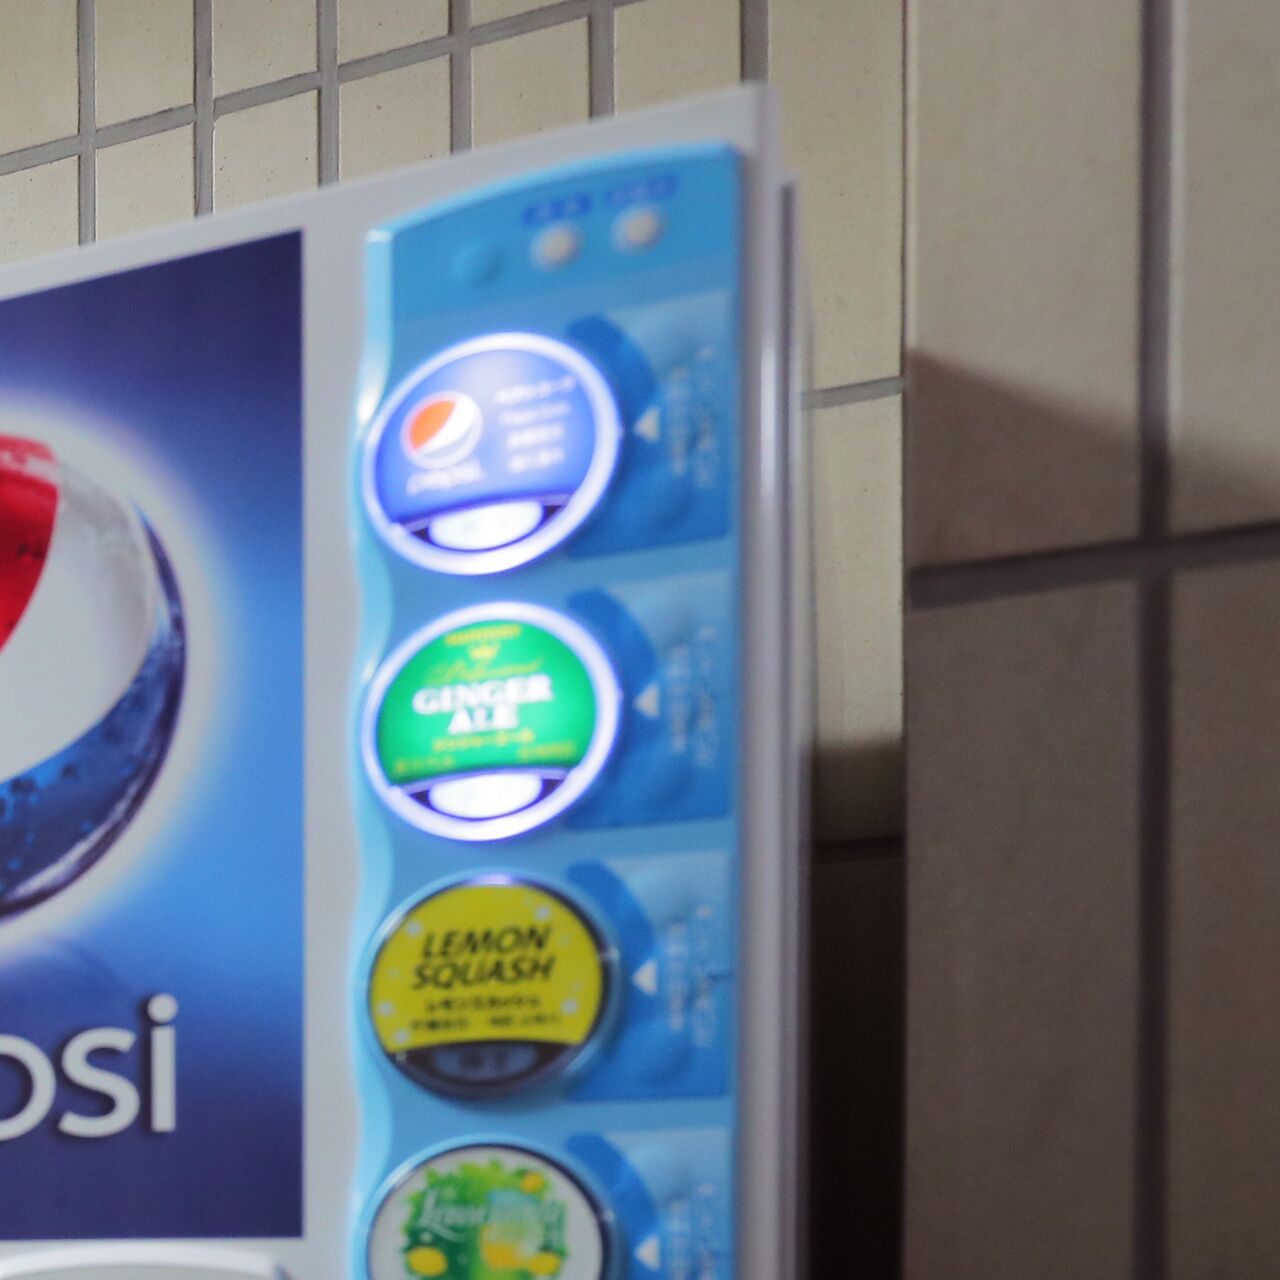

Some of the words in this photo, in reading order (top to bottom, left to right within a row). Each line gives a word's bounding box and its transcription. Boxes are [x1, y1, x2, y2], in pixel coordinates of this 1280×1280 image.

[411, 674, 553, 715] GINGER
[447, 702, 520, 735] ALE
[422, 924, 552, 960] LEMON
[411, 953, 556, 991] SQUASH
